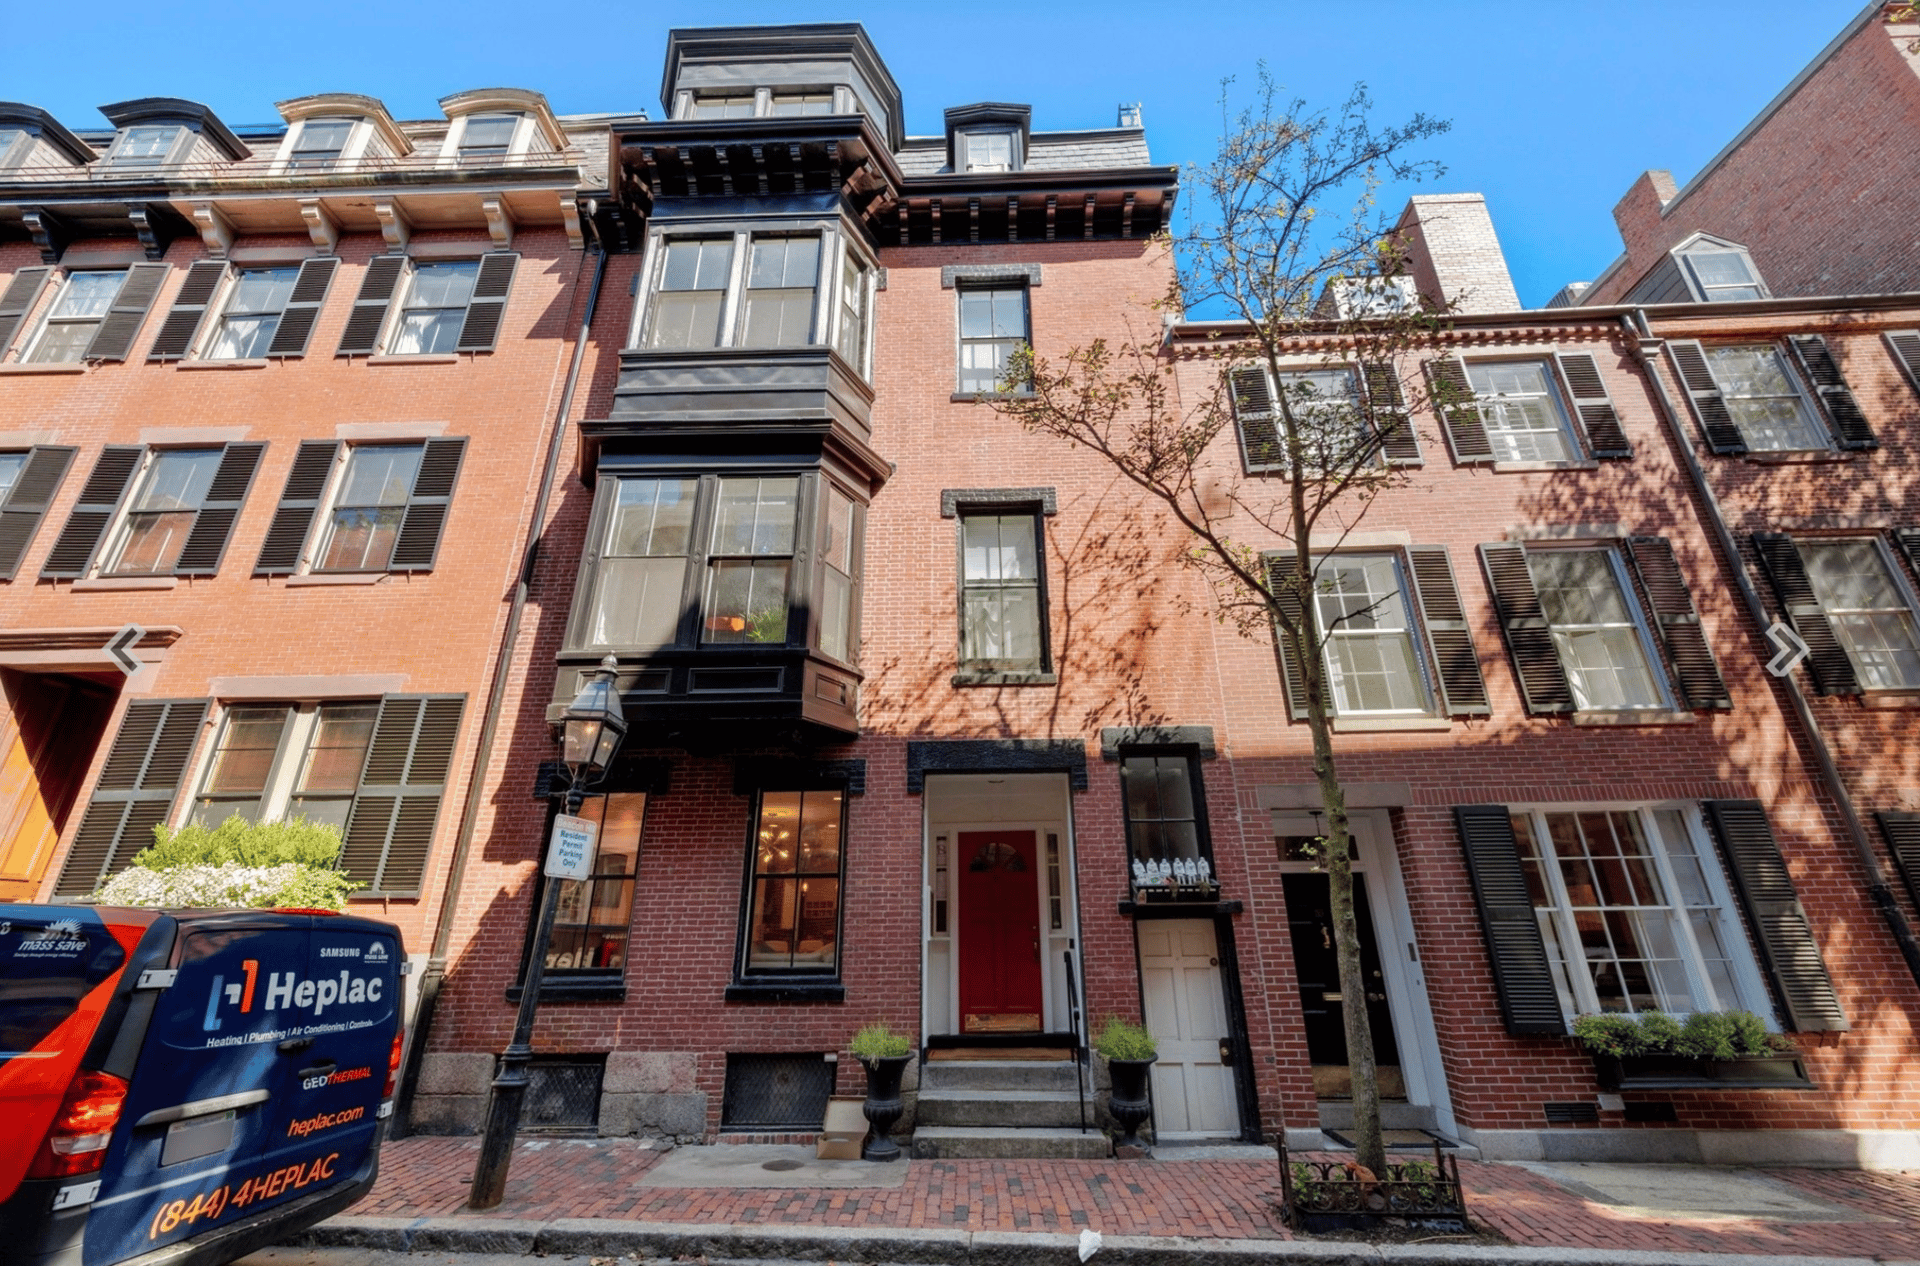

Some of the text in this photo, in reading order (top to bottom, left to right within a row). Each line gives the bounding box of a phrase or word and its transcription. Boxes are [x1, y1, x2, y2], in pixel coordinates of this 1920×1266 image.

[561, 830, 588, 841] Resident
[562, 840, 583, 849] Permit
[559, 849, 583, 860] Parking
[562, 859, 576, 869] Only
[17, 941, 88, 951] mass save
[320, 947, 361, 957] SAMSUNG
[265, 970, 383, 1016] Heplac
[207, 1019, 374, 1047] Heating Plumbing Air Conditioning Controls
[287, 1106, 365, 1137] heplac.com
[150, 1153, 340, 1240] (844) 4HEPLAC
